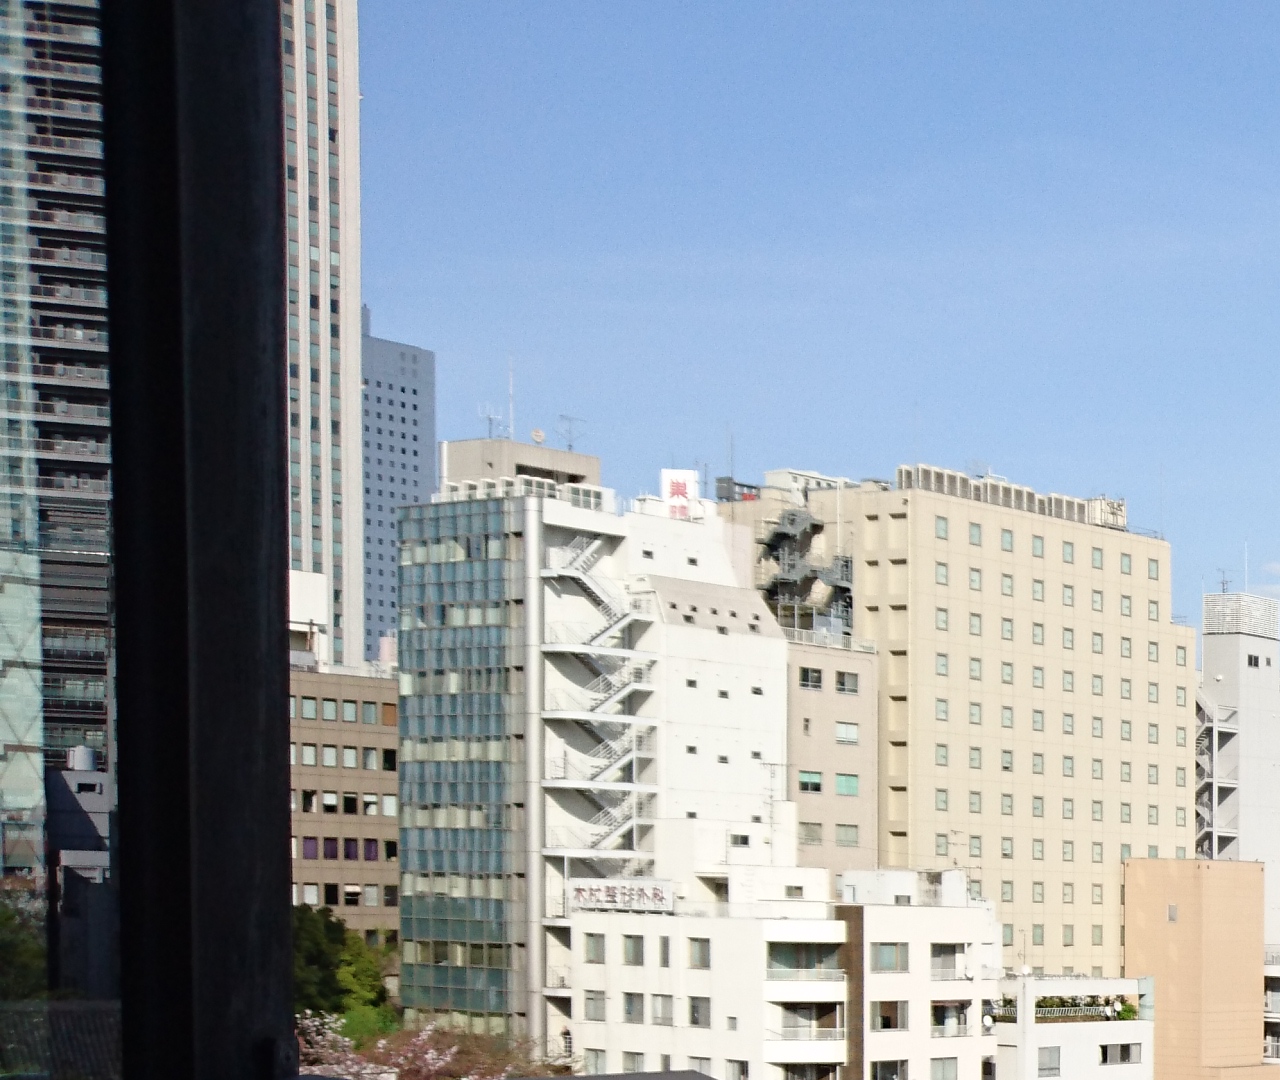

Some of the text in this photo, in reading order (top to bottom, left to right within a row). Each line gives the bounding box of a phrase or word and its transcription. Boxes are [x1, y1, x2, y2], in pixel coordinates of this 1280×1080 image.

[573, 885, 666, 906] 木村整形外科
